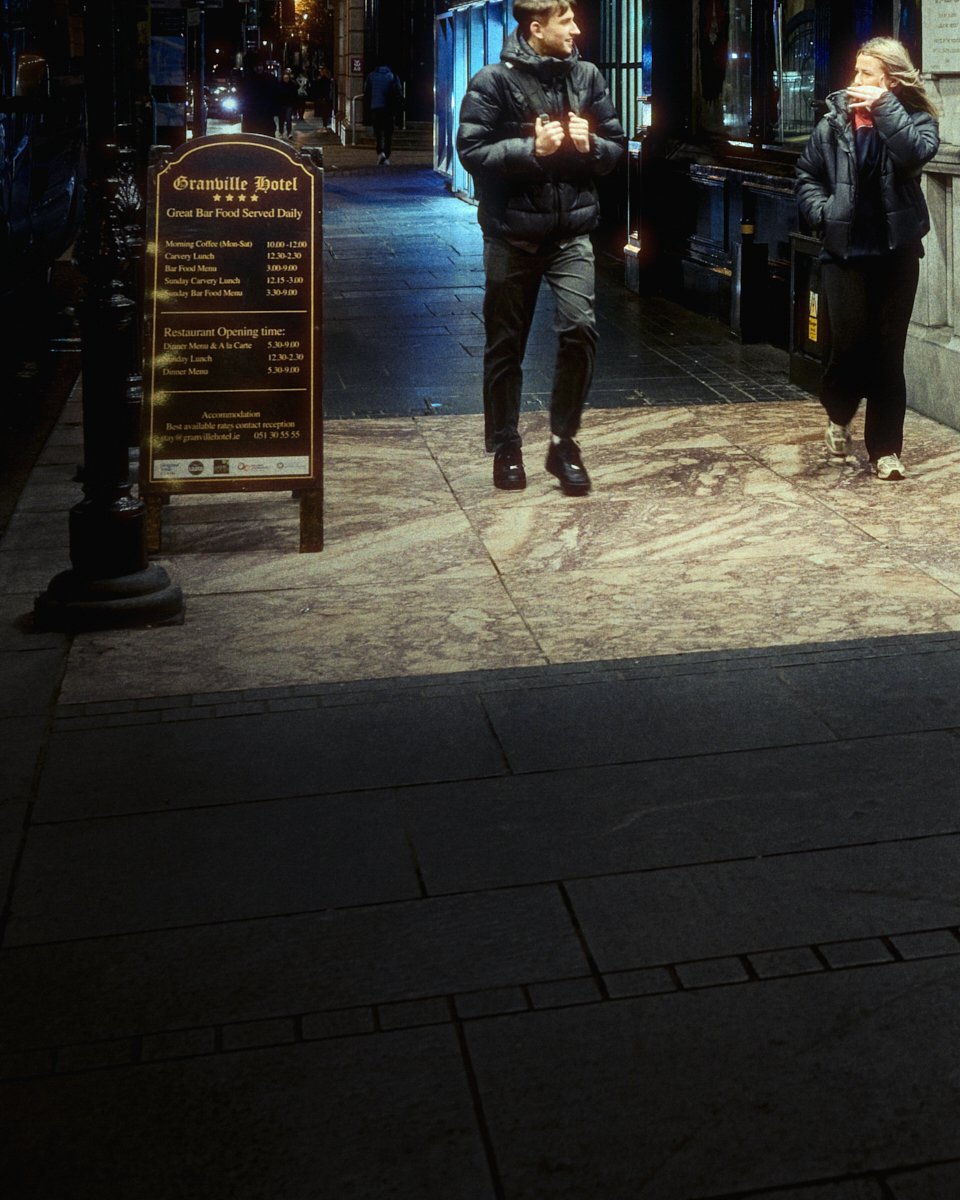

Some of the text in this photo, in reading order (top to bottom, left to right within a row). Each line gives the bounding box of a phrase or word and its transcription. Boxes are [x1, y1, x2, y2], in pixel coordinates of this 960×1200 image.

[172, 175, 298, 193] Granville Hotel
[166, 208, 303, 220] Great Bar Food Served Daily
[165, 240, 194, 249] Morning
[195, 240, 219, 248] Coffee
[164, 253, 191, 262] Carvery
[266, 252, 302, 260] 12.30-2.30
[266, 264, 298, 272] 3.00-9.00
[164, 277, 189, 286] Sunday
[190, 277, 218, 286] Carvery
[219, 277, 241, 285] Lunch
[190, 289, 203, 297] Bar
[204, 289, 222, 297] Food
[223, 289, 243, 297] Menu
[266, 289, 298, 297] 3.30-9.00
[163, 325, 286, 339] Restaurant Opening time:
[233, 341, 253, 349] Carte
[267, 341, 300, 349] 5.30-9.00
[190, 354, 213, 363] Lunch
[268, 353, 304, 361] 12.30-2.30
[162, 368, 186, 376] Dinner
[267, 366, 300, 374] 5.30-9.00
[201, 410, 261, 419] Accommodation
[166, 422, 183, 431] Best
[183, 422, 216, 431] available
[235, 421, 261, 429] contact
[262, 420, 295, 429] reception
[253, 431, 267, 440] 051
